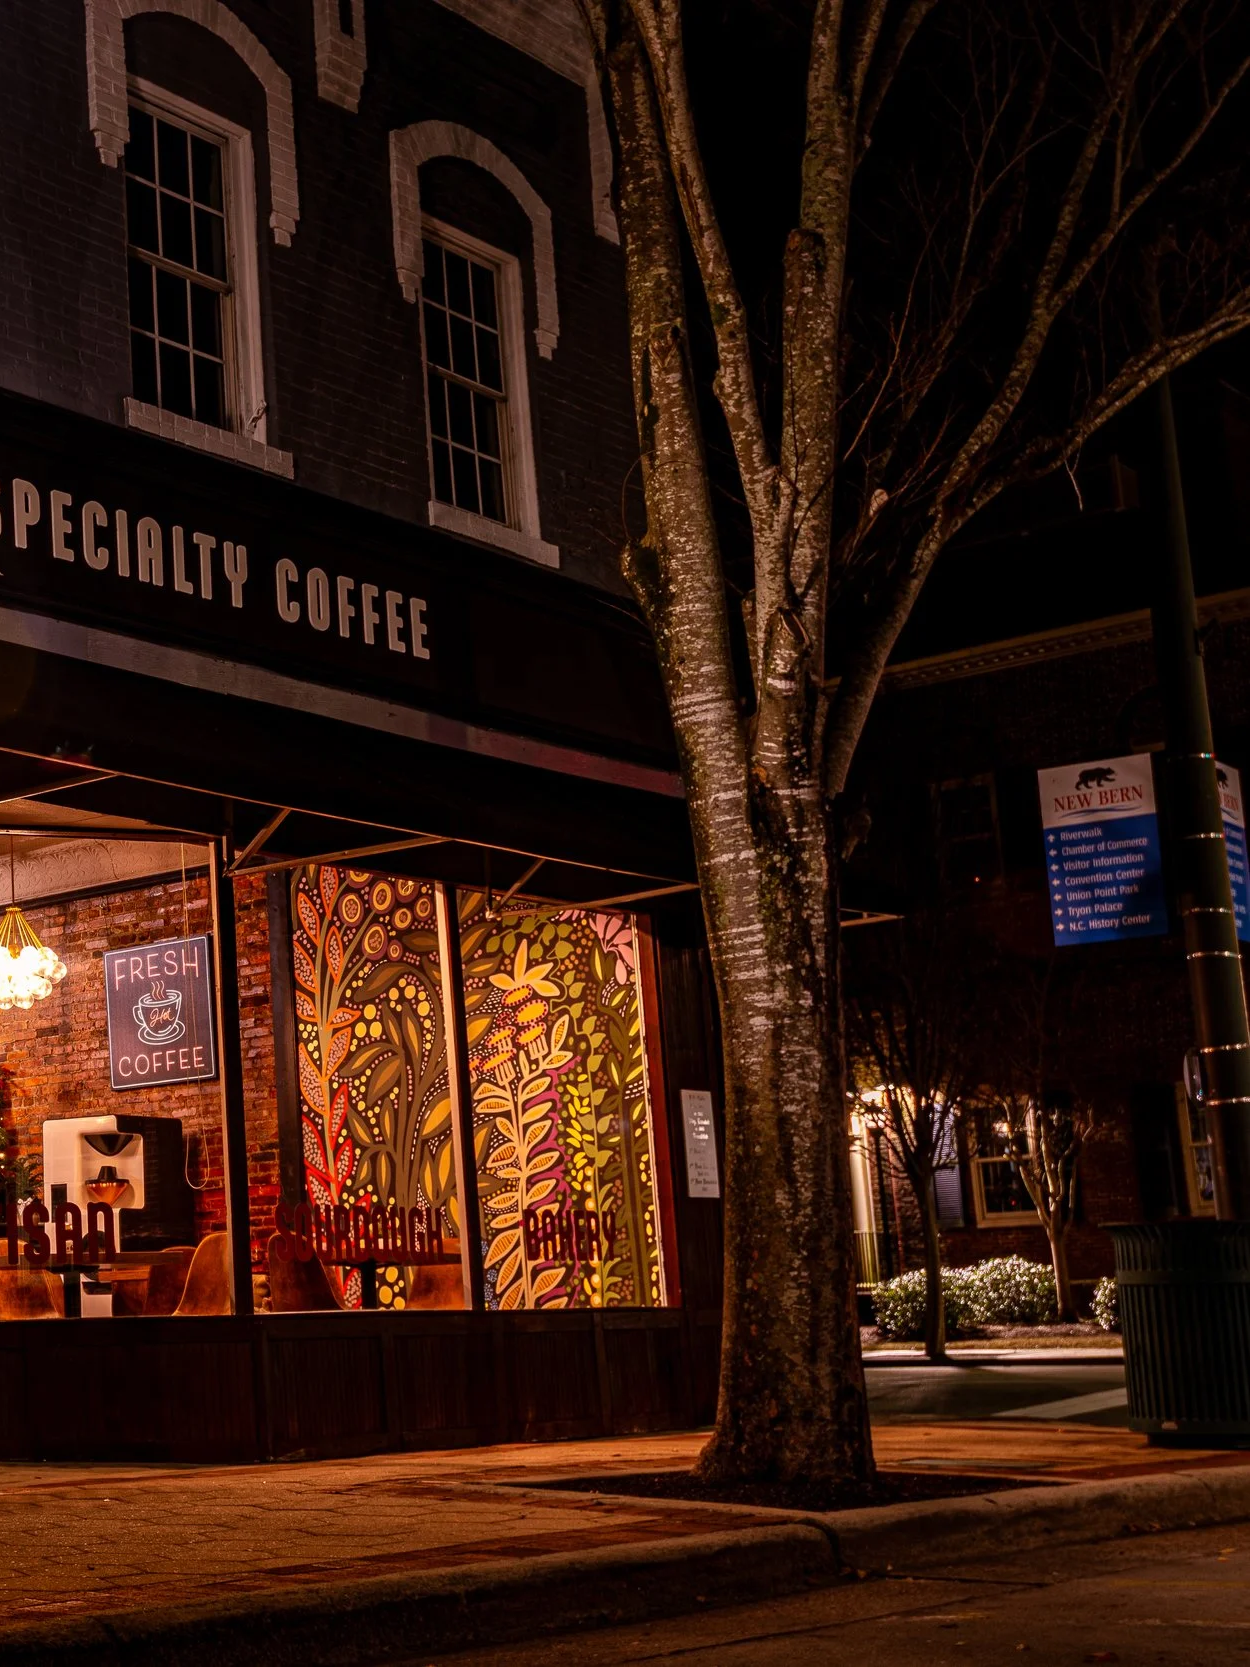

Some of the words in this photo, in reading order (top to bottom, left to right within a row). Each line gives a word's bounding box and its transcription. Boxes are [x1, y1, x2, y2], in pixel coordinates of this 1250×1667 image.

[275, 557, 431, 660] COFFEE
[1054, 793, 1092, 812] NEW
[1099, 784, 1143, 806] BERN
[1060, 827, 1102, 841] Riverwalk
[1062, 844, 1095, 857] Chamber
[1097, 841, 1105, 851] of
[1107, 836, 1148, 850] Commerce
[1063, 860, 1090, 871] Visitor
[1093, 853, 1143, 868] Information
[1065, 873, 1113, 886] Convention
[1116, 867, 1145, 880] Center
[1067, 890, 1091, 901] Union
[1094, 887, 1117, 899] Point
[1120, 883, 1139, 895] Park
[1068, 905, 1091, 918] Tryon
[1094, 902, 1123, 914] Palace
[1070, 921, 1086, 932] N.C.
[1089, 918, 1119, 931] History
[1122, 912, 1150, 926] Center
[114, 947, 199, 991] FRESH
[150, 1008, 175, 1027] Hot
[119, 1046, 205, 1077] COFFEE
[274, 1203, 447, 1263] SOURDOUGH
[522, 1208, 616, 1262] BAKERY
